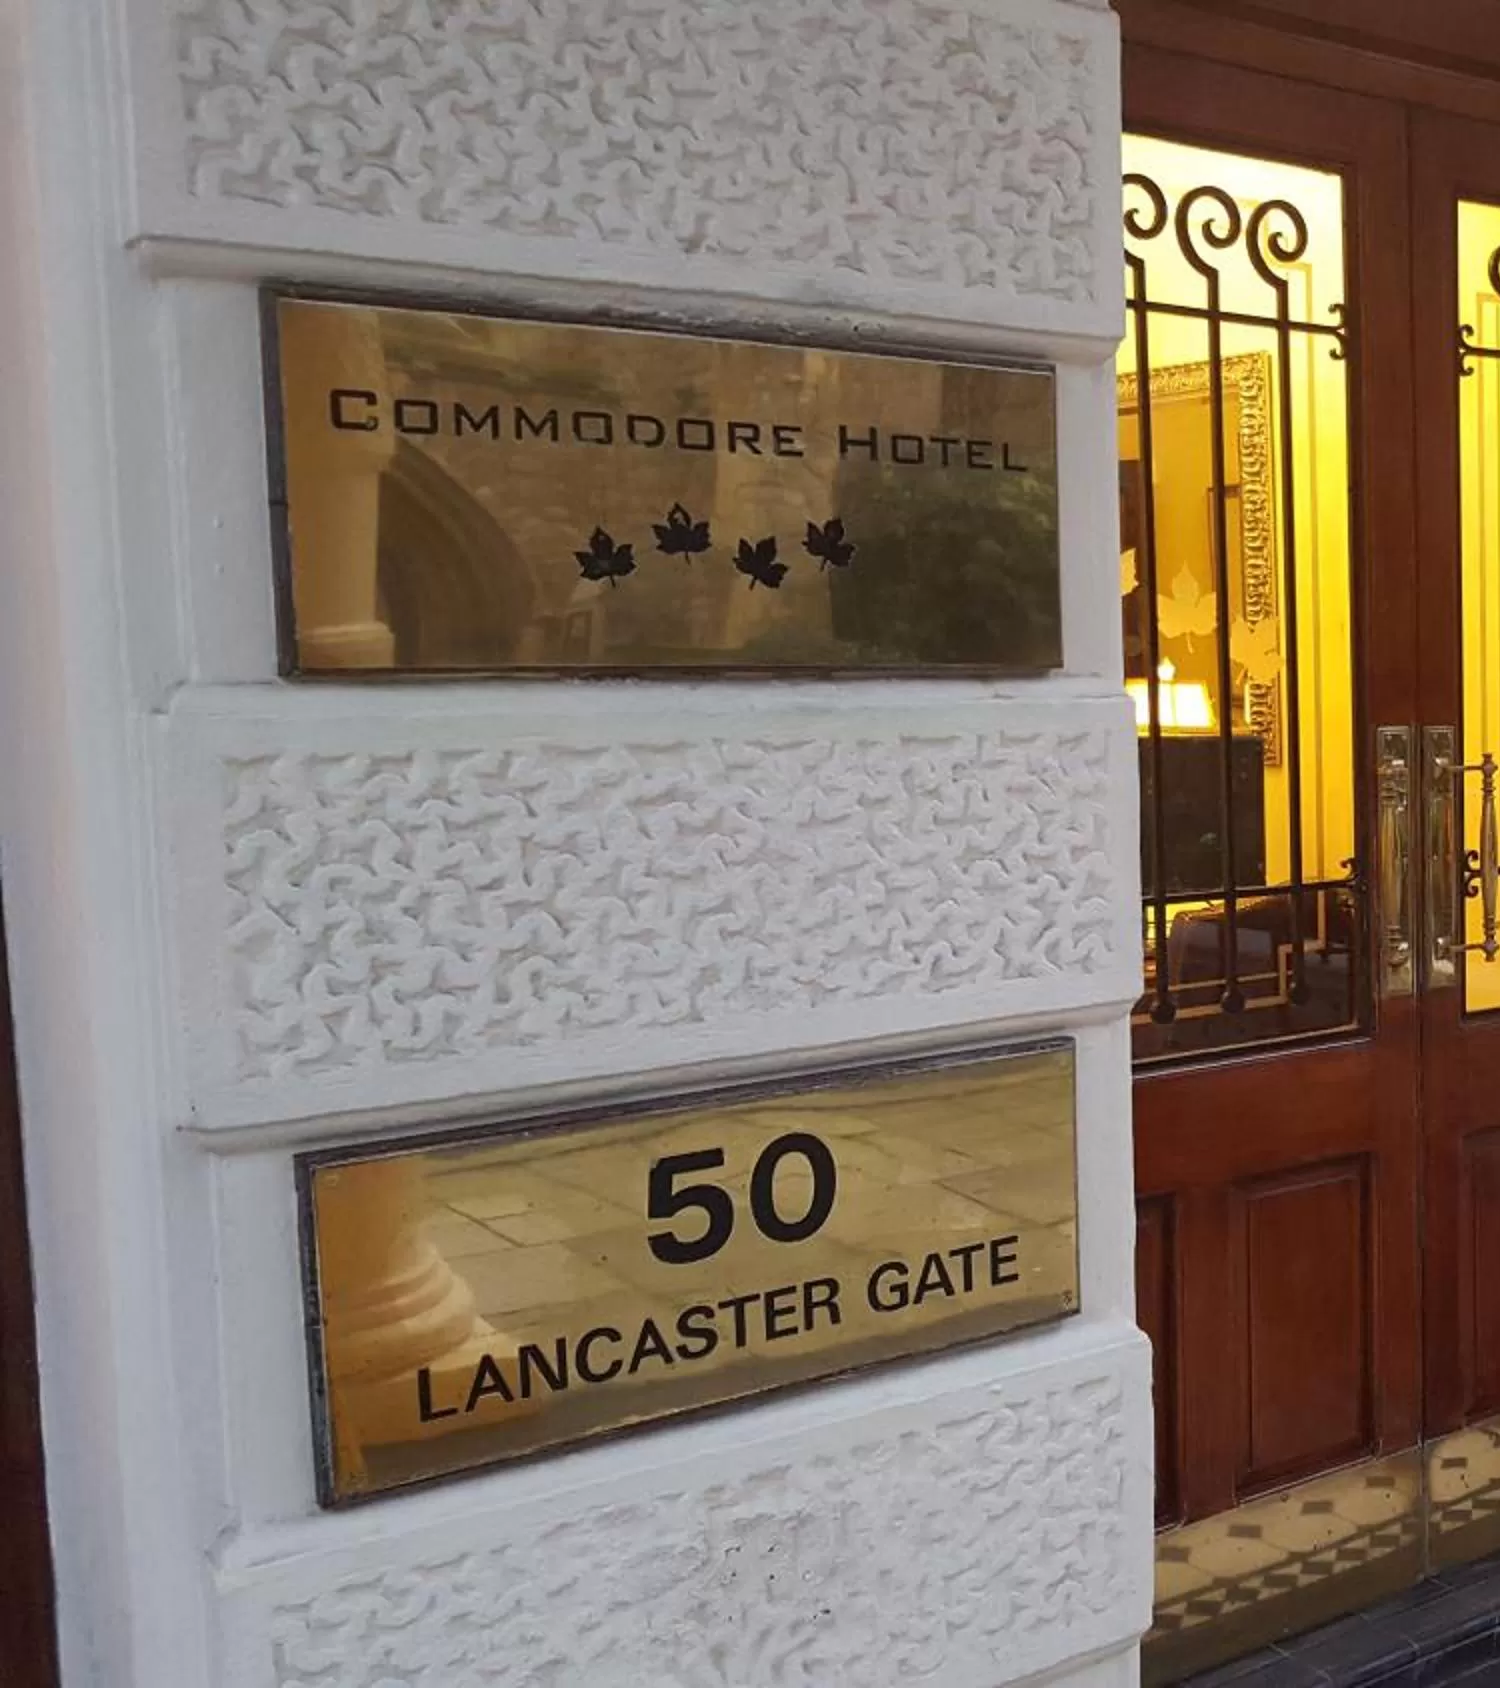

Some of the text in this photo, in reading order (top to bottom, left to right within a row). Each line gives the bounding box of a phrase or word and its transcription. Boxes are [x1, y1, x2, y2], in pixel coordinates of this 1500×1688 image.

[330, 389, 1028, 473] COMMODORE HOTEL
[647, 1132, 837, 1264] 50
[418, 1236, 1020, 1423] LANCASTER GATE
